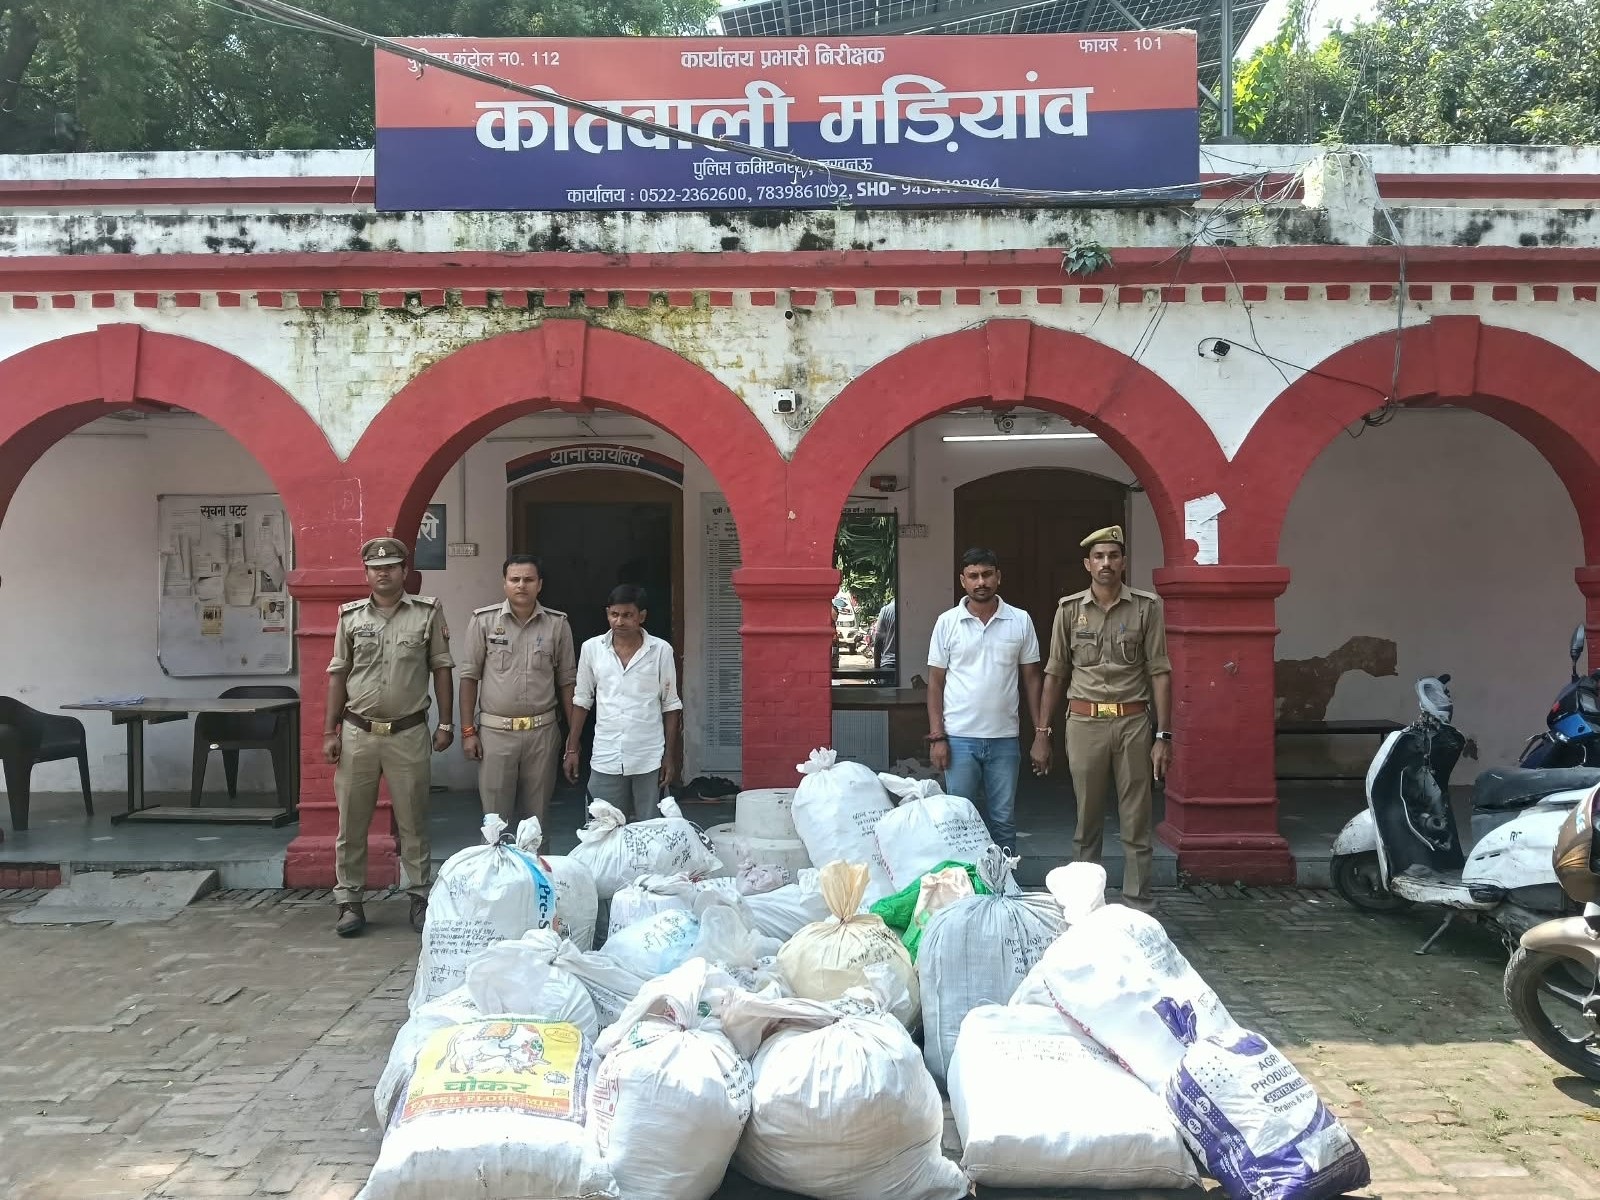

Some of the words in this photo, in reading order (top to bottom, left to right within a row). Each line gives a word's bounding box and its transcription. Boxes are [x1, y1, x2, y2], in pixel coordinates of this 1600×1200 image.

[1079, 37, 1119, 54] फायर
[1134, 37, 1163, 51] 101
[532, 51, 559, 66] 112
[681, 47, 753, 69] कार्यालय
[761, 44, 808, 68] प्रभारी
[816, 43, 885, 66] निरीक्षक
[475, 80, 795, 154] कोतवाली
[819, 71, 1094, 153] मड़ियांव
[692, 158, 731, 180] पुलिस
[566, 185, 626, 203] कार्यालय
[639, 187, 752, 203] 0522-2362600,
[756, 184, 853, 201] 7839861092,
[857, 181, 896, 197] SHO-
[550, 447, 587, 464] थाना
[200, 505, 225, 520] सूचना
[1257, 1053, 1280, 1071] AGRI
